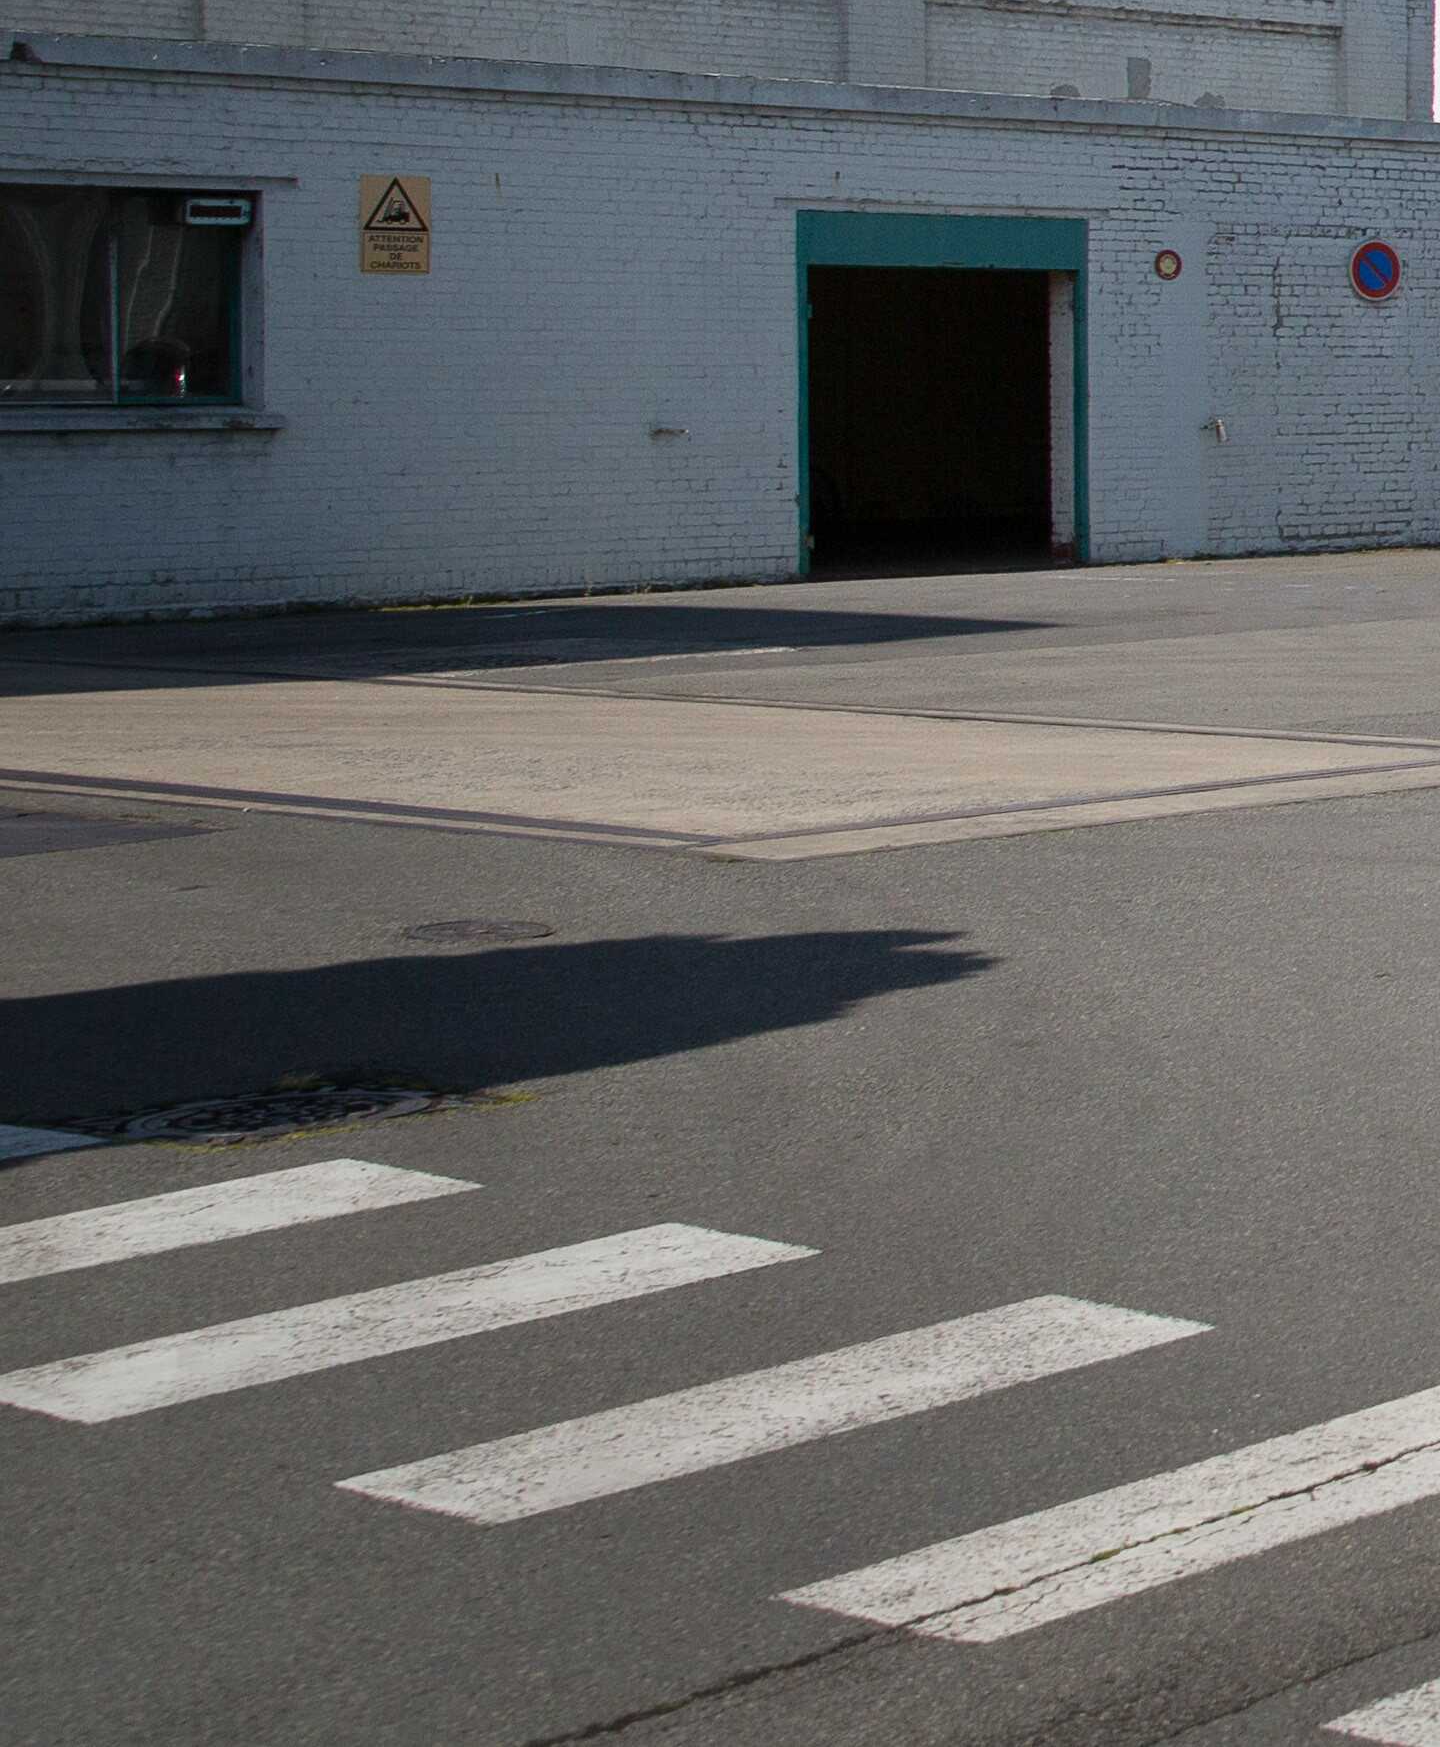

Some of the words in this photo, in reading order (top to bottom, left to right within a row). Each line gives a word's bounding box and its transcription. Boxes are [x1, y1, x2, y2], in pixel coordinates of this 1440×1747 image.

[368, 235, 424, 244] ATTENTION
[373, 243, 418, 252] PASSAGE
[390, 252, 402, 261] DE
[369, 260, 422, 269] CHARIOTS
